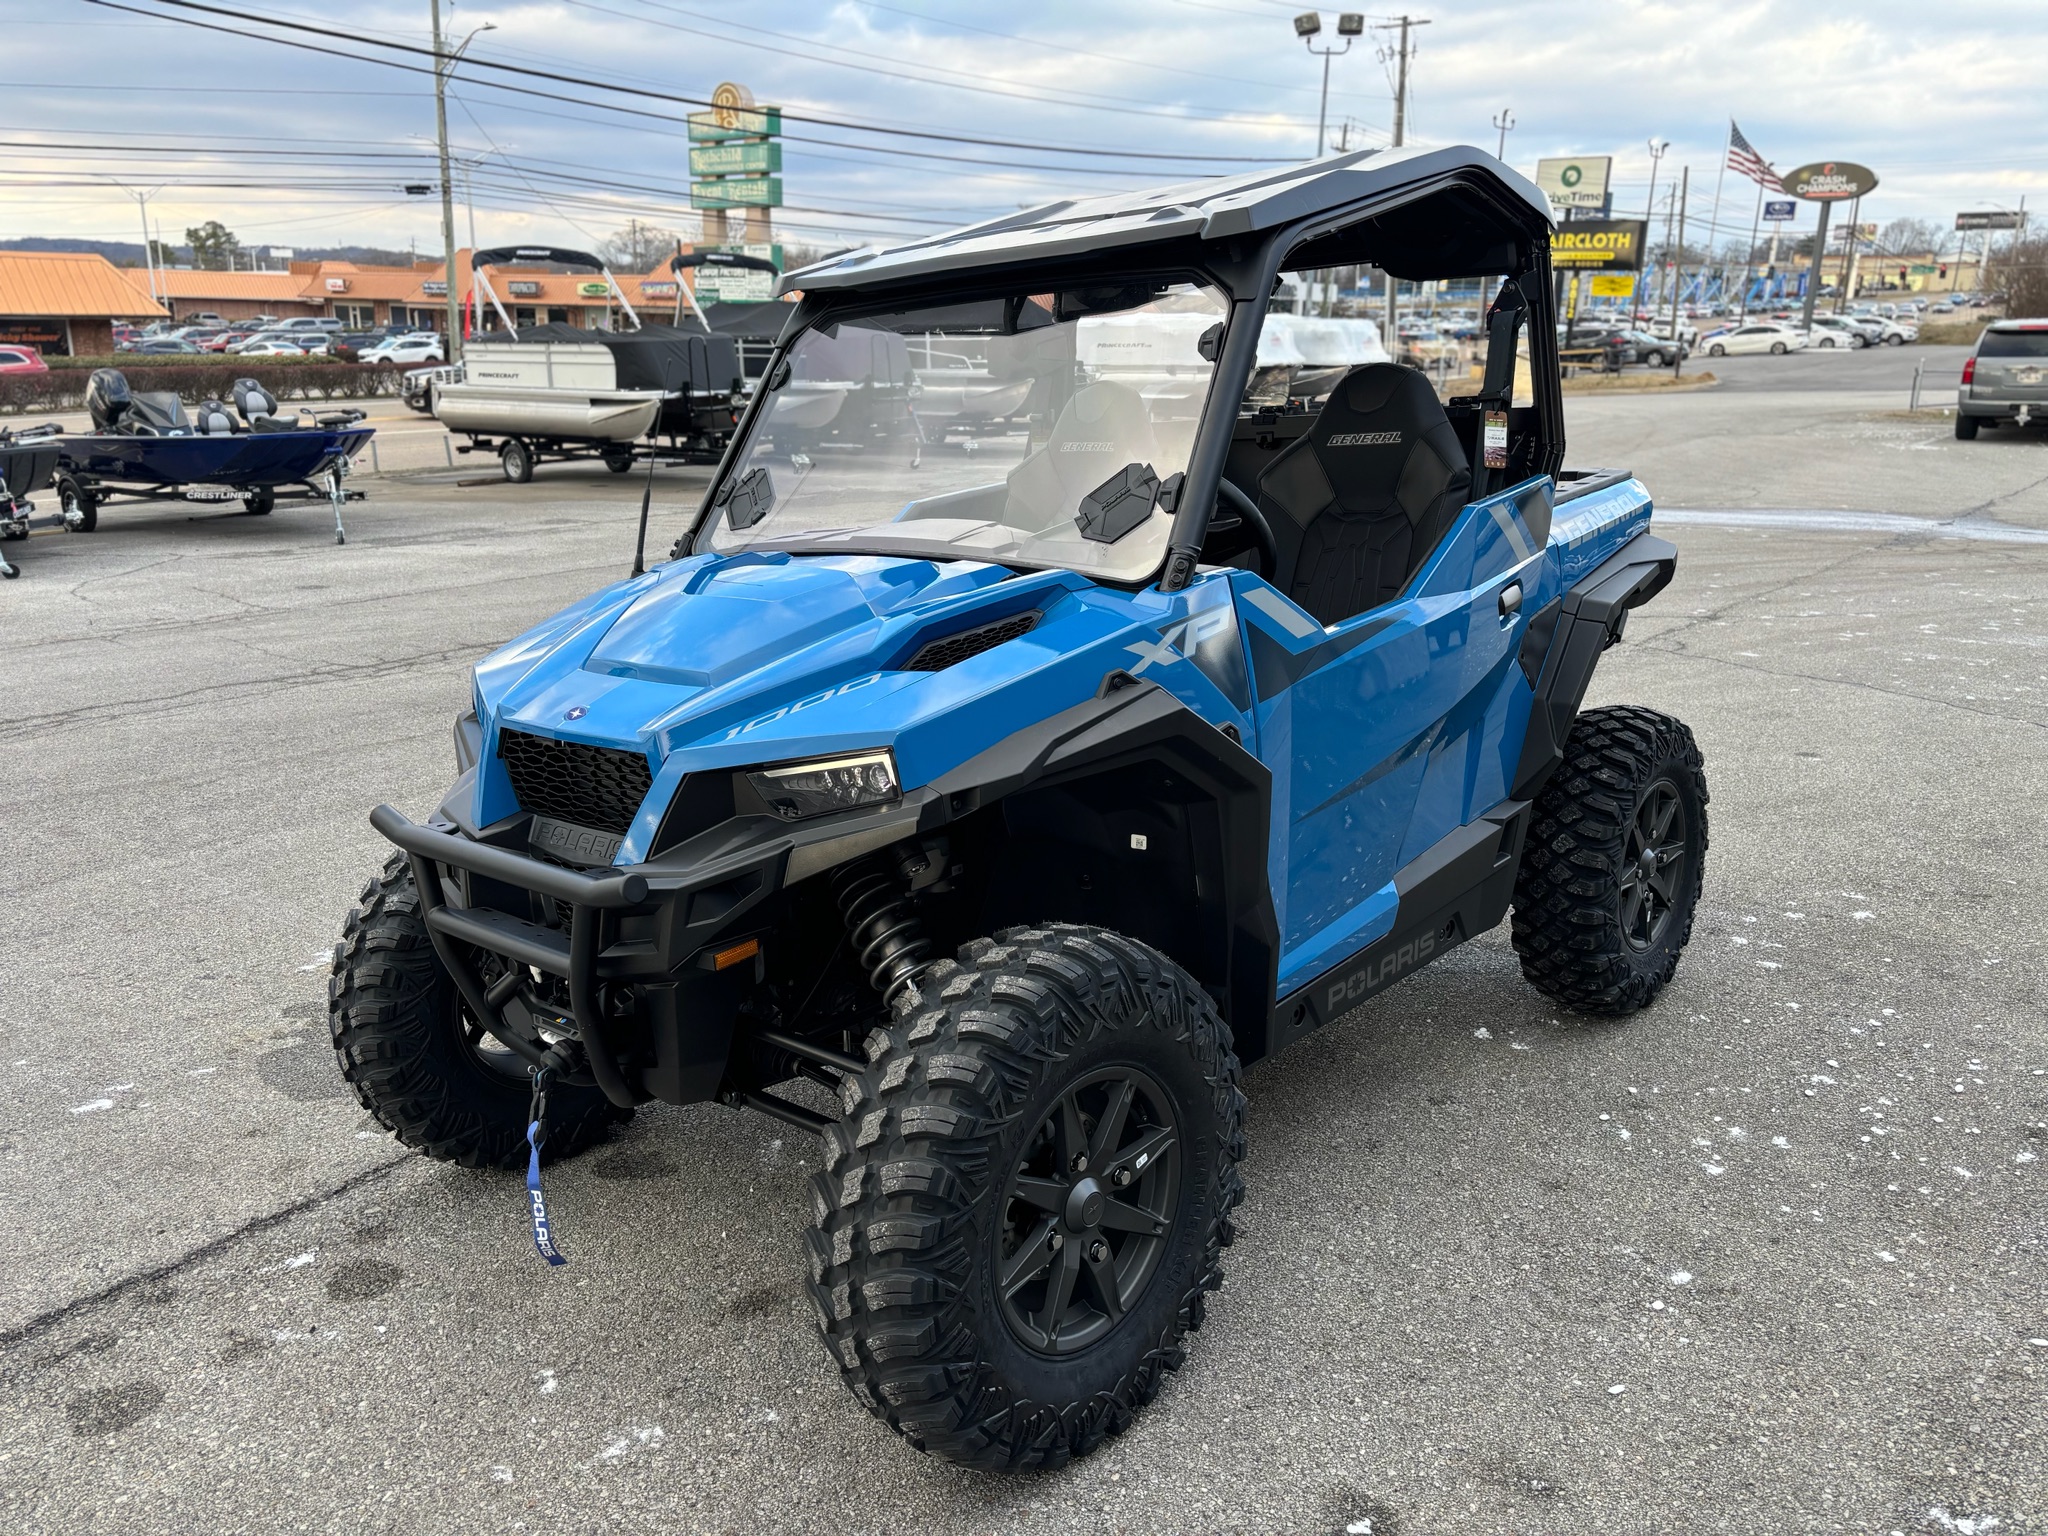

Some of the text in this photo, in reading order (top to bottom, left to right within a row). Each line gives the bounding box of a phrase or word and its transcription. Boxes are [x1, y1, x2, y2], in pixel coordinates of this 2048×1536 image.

[1811, 175, 1847, 185] CRASH
[1797, 183, 1857, 193] CHAMPIONS
[1549, 192, 1602, 203] riveTime
[1550, 233, 1631, 248] AIRCLOTH
[1327, 432, 1402, 446] GENERAL
[1060, 442, 1115, 452] GENERAL
[186, 491, 253, 499] CRESTLINER
[1122, 604, 1231, 676] XP
[726, 673, 882, 740] 1000
[536, 821, 623, 860] POLARIS
[1327, 928, 1436, 1012] POLARIS
[530, 1189, 557, 1257] POLARIS
